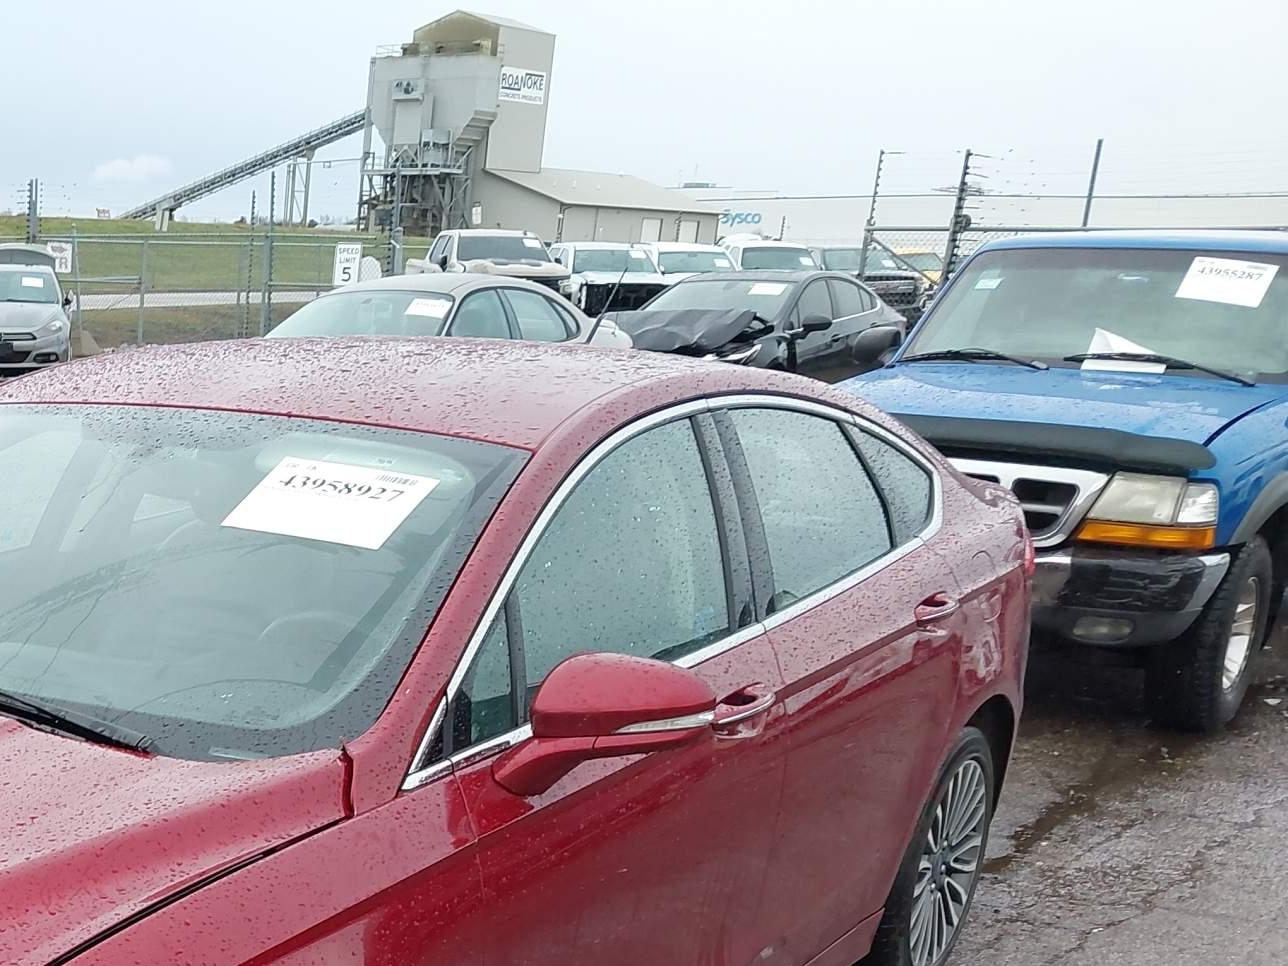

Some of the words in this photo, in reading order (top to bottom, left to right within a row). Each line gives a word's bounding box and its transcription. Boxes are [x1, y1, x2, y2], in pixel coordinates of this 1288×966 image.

[501, 72, 544, 91] ROANOKE
[338, 247, 360, 255] SPEED
[339, 256, 357, 264] LIMIT
[341, 266, 352, 282] 5
[1198, 266, 1264, 281] 43955287
[279, 474, 405, 502] 43958927
